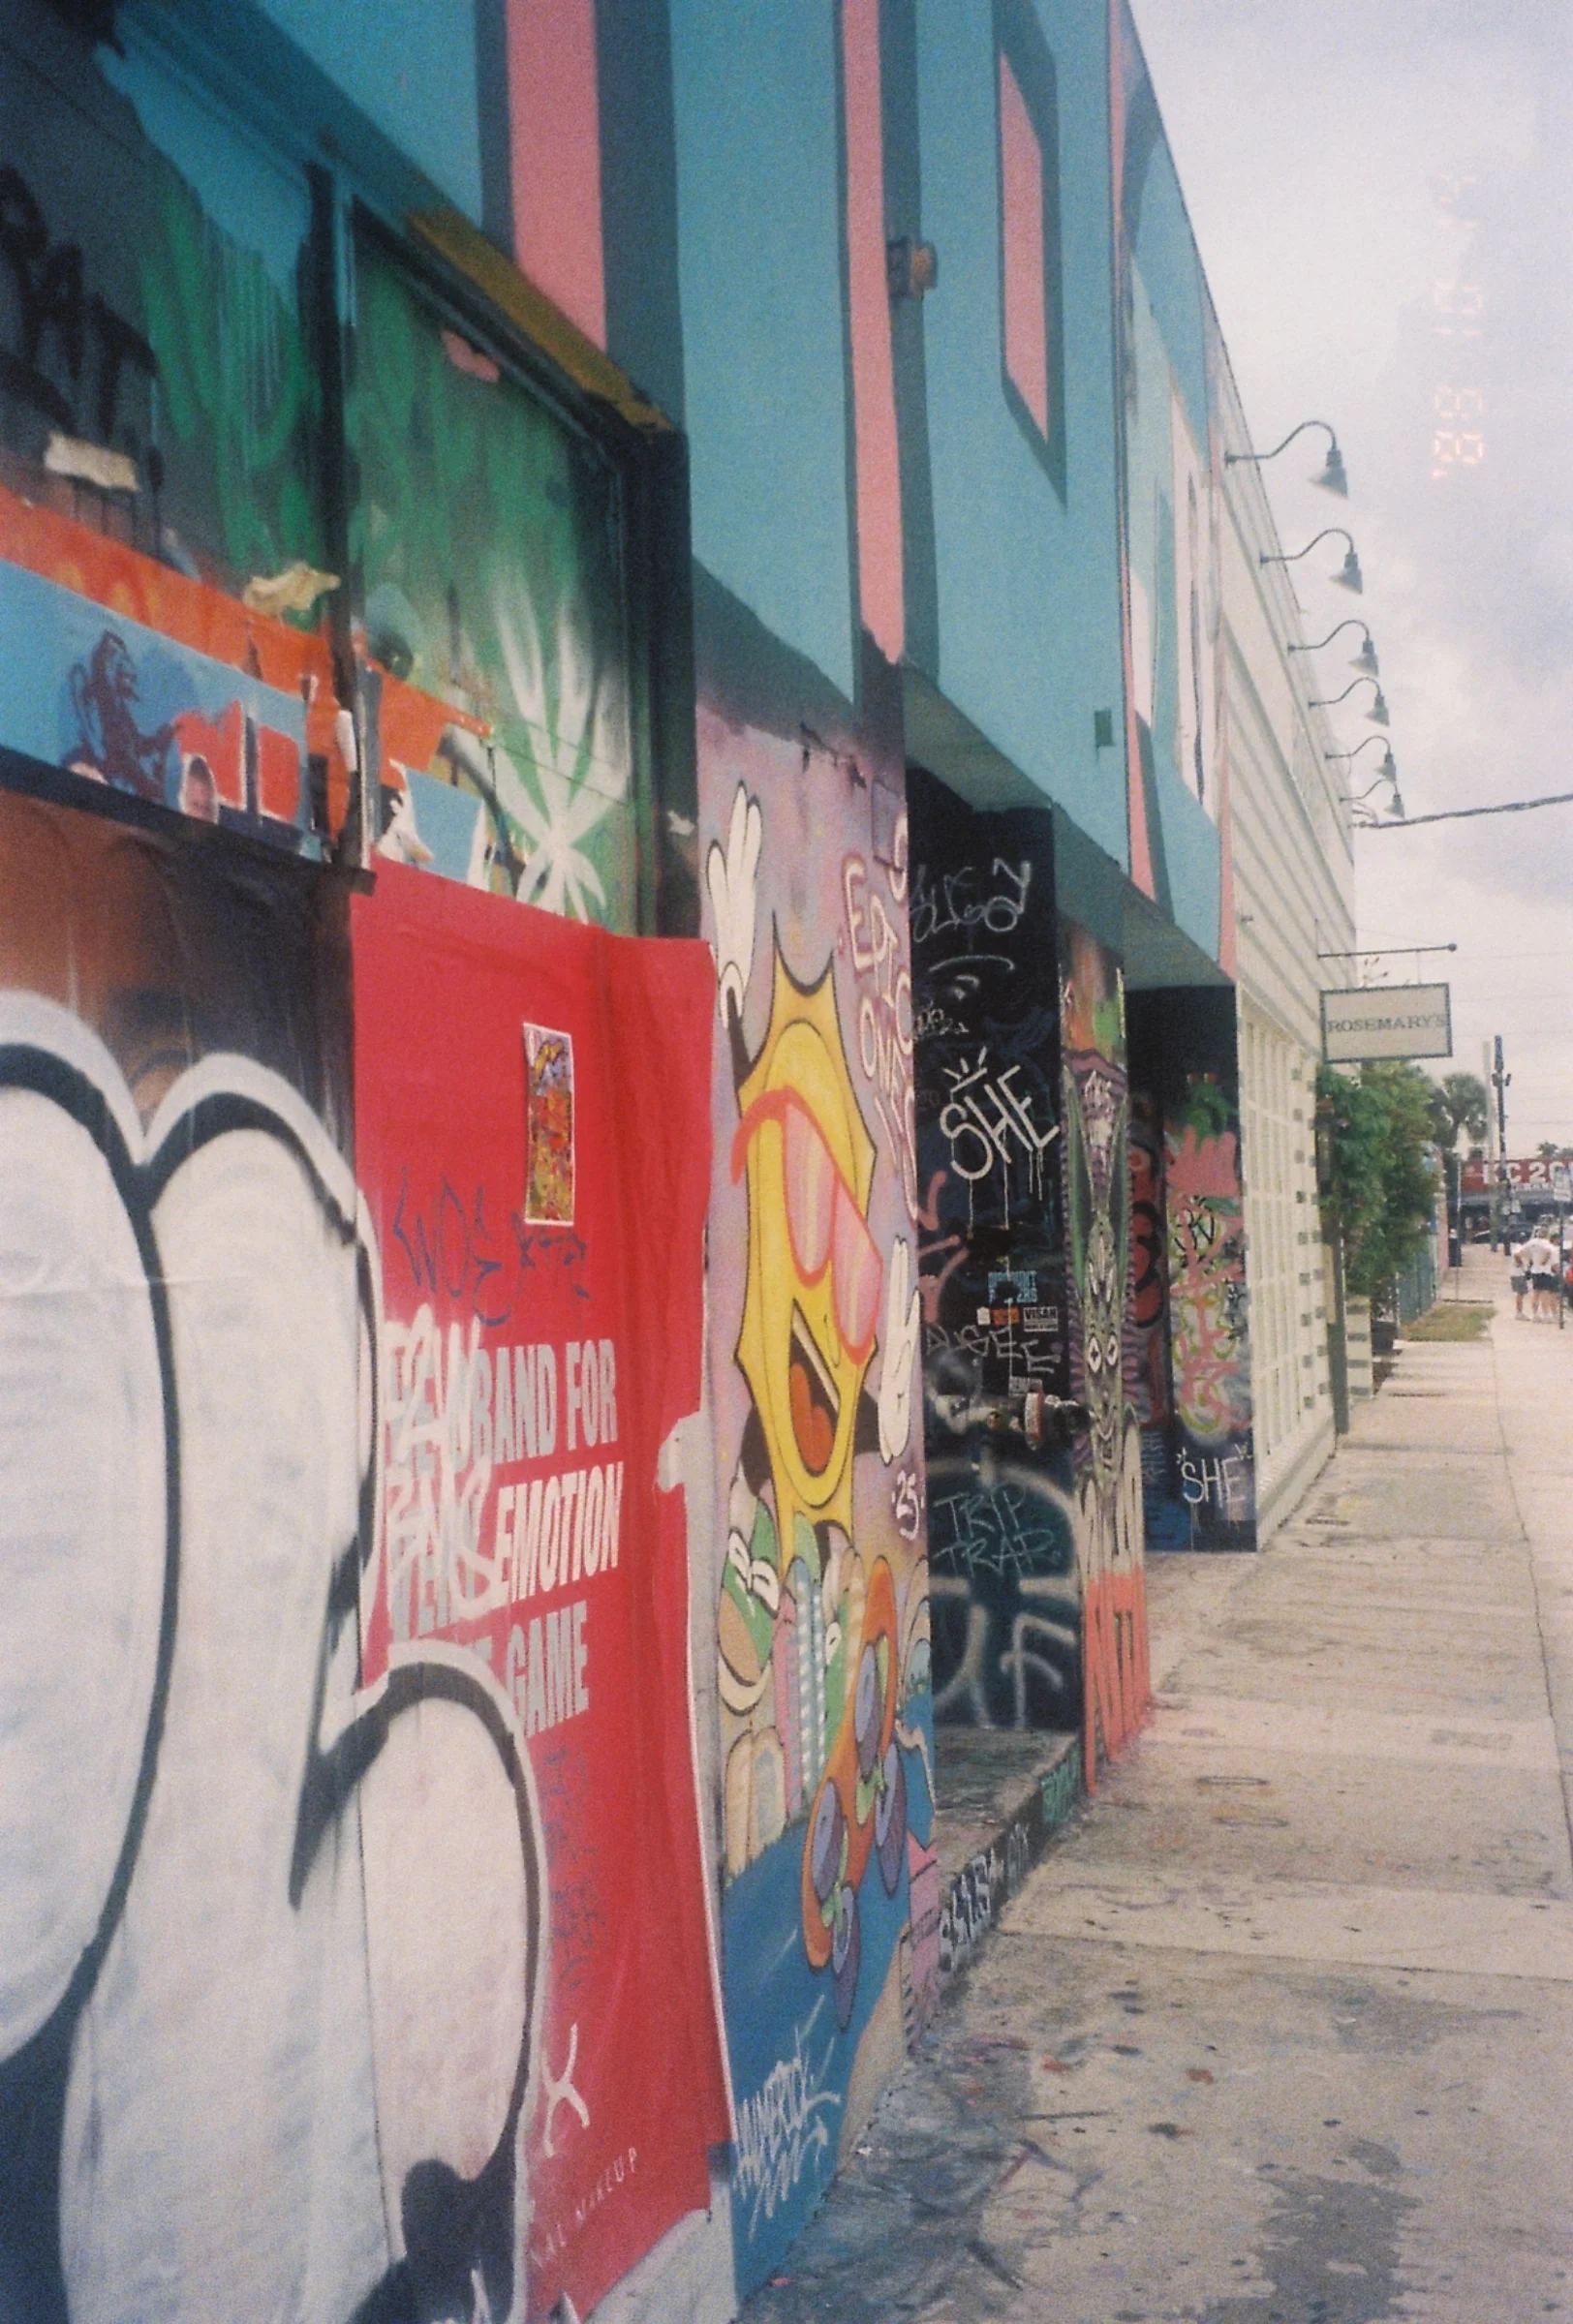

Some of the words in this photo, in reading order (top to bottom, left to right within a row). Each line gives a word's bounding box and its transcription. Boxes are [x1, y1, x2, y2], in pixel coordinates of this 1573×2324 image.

[1327, 1015, 1445, 1033] ROSEMARY'S
[940, 1064, 1060, 1180] SHE
[566, 1339, 618, 1451] FOR
[494, 1460, 625, 1605] EMOTION
[933, 1482, 1027, 1541] TRIP
[1181, 1455, 1247, 1509] SHE
[505, 1600, 590, 1739] GAME
